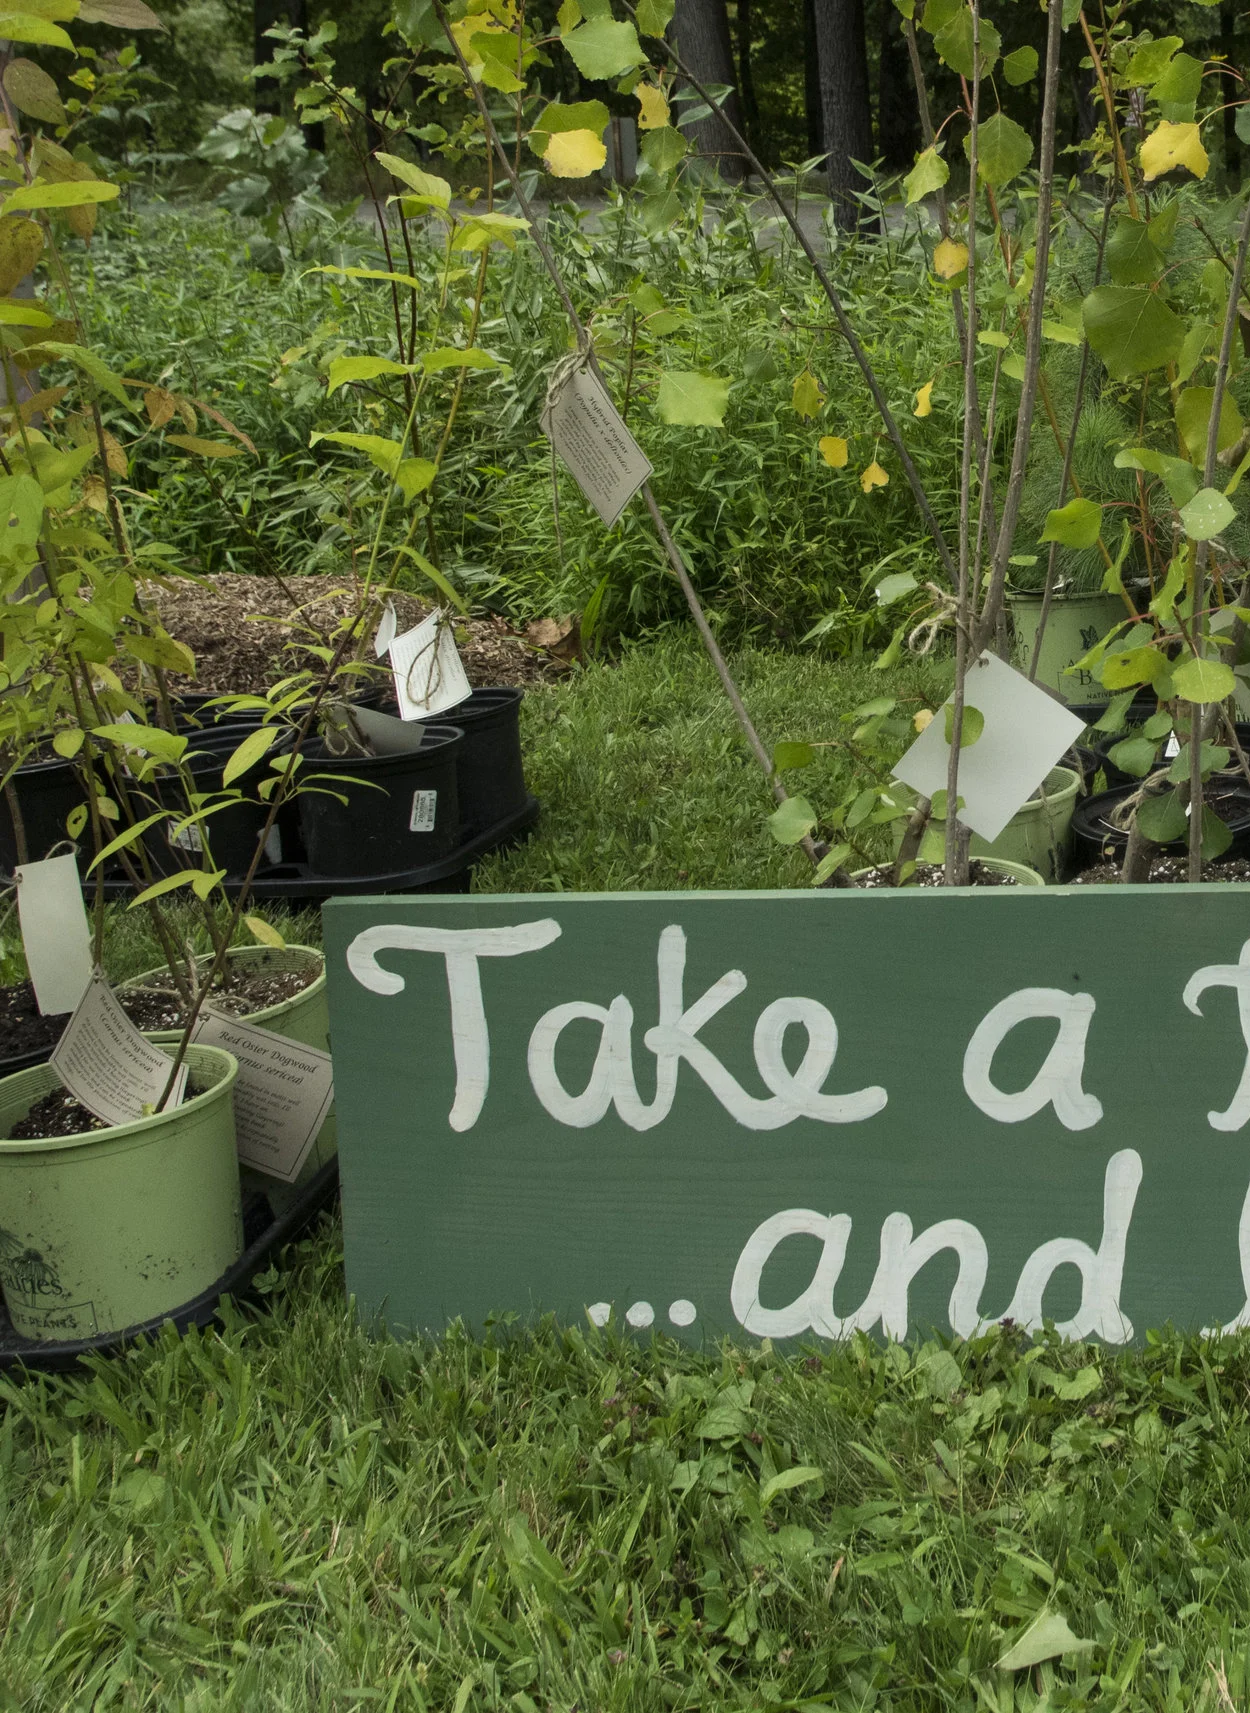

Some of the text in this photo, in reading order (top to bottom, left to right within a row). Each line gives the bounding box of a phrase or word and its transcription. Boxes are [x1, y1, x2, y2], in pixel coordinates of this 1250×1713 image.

[587, 393, 628, 456] Hybrid Poplar
[125, 1034, 166, 1068] Dogwood
[347, 918, 888, 1132] Take
[963, 987, 1103, 1131] a
[218, 1030, 319, 1074] Red Osier Dogwood
